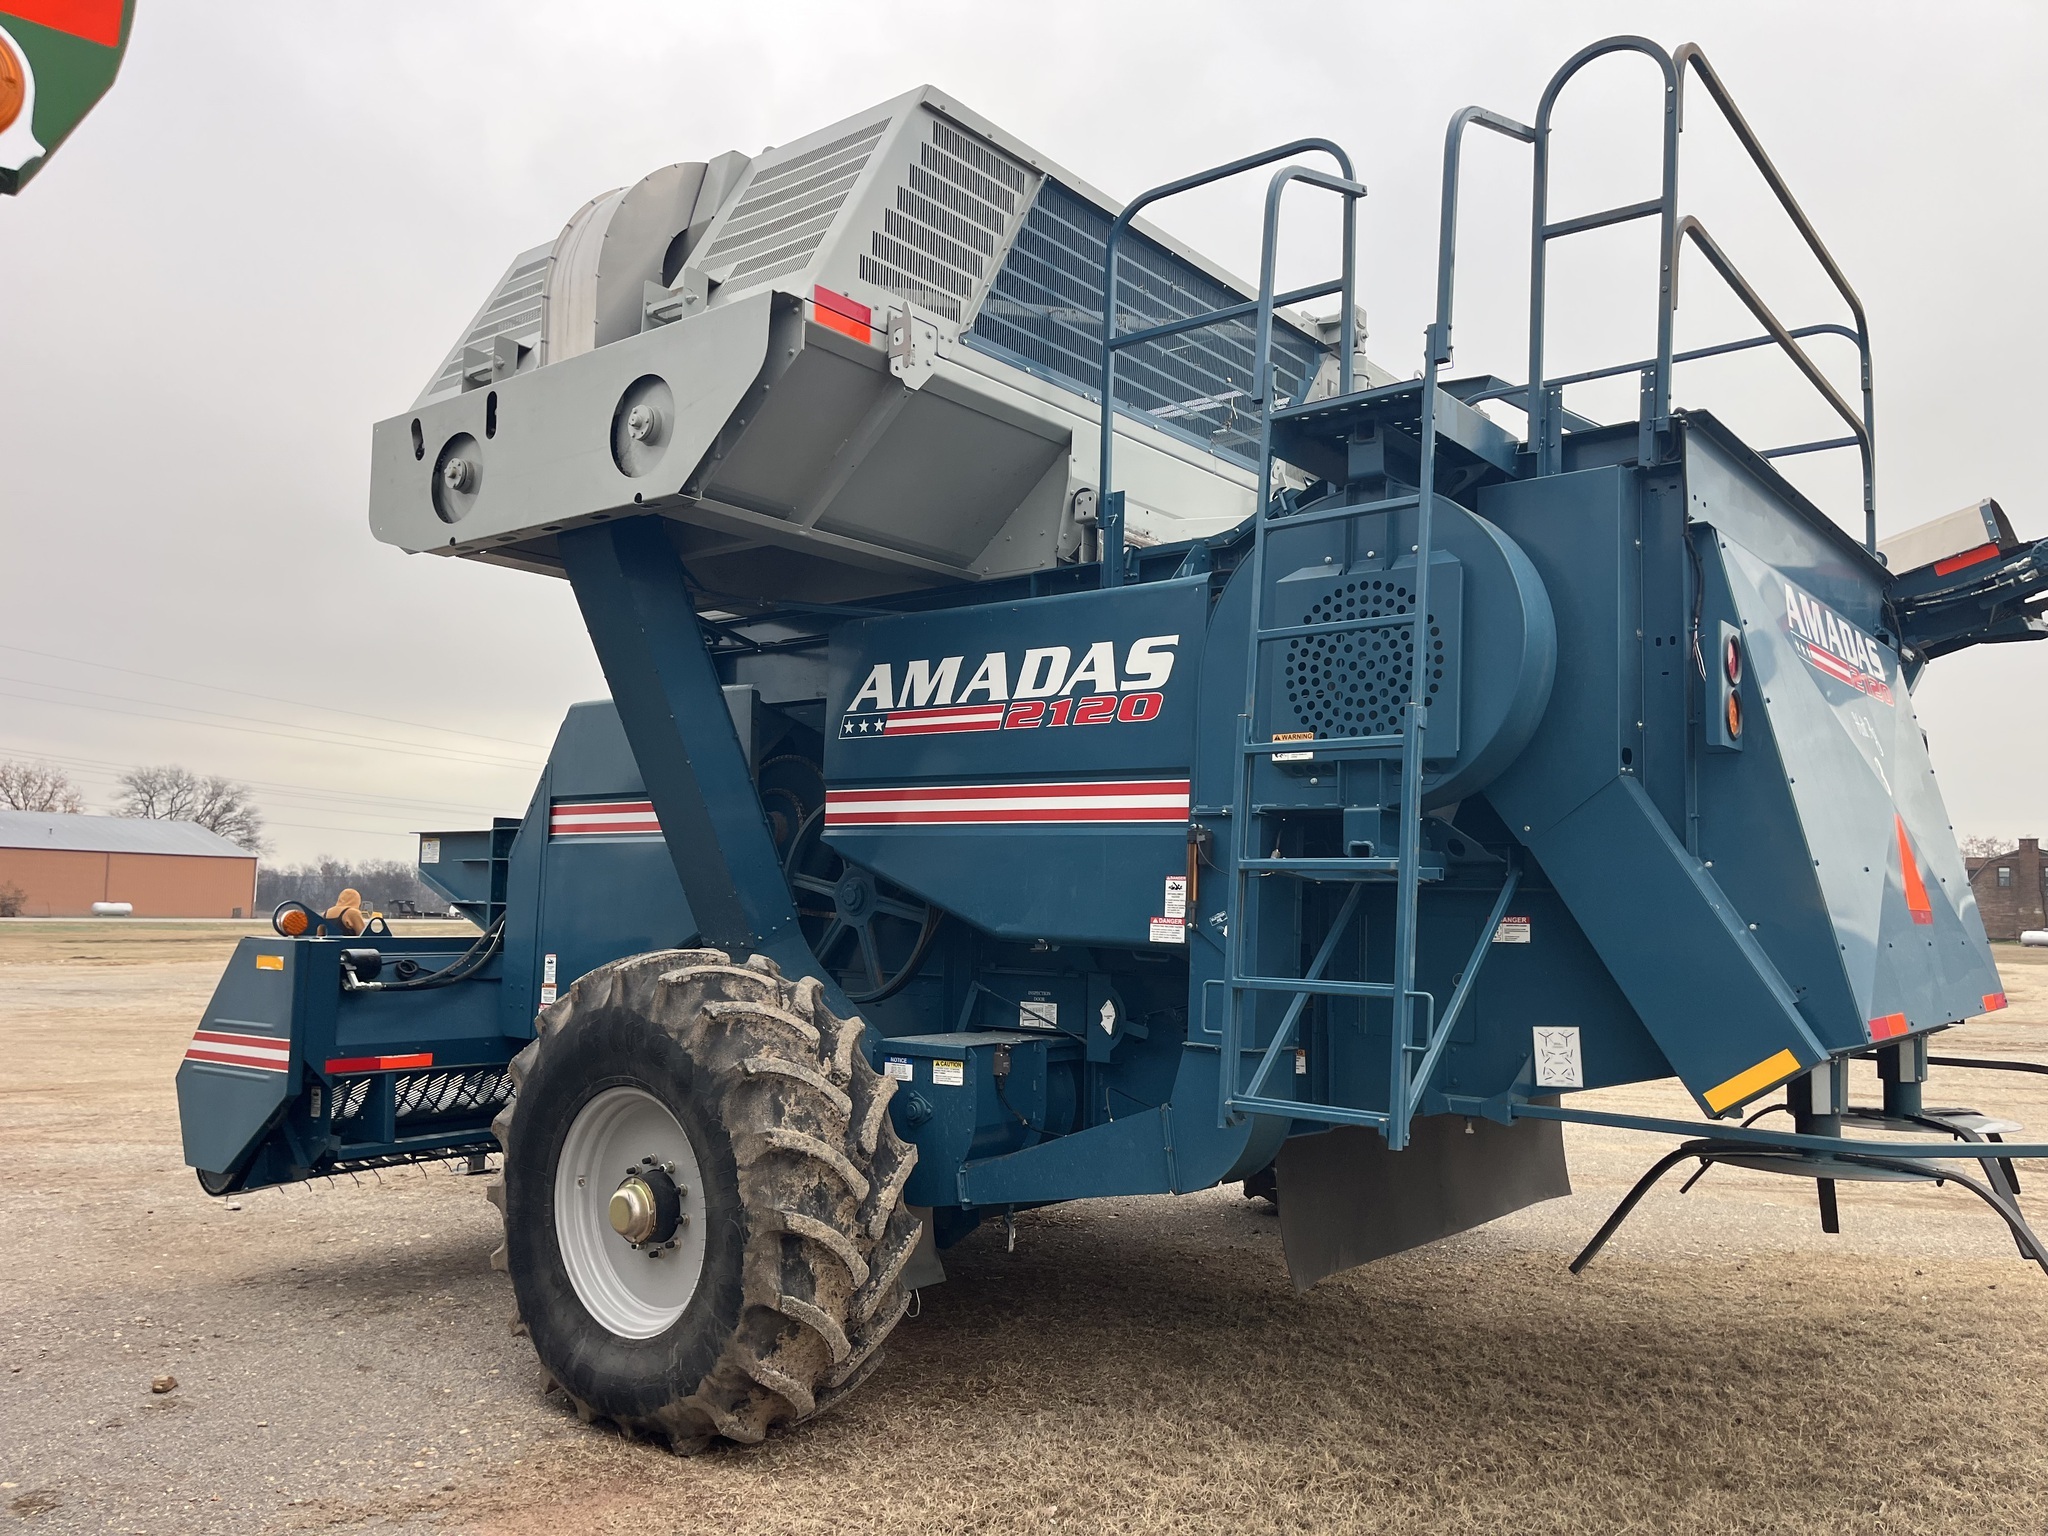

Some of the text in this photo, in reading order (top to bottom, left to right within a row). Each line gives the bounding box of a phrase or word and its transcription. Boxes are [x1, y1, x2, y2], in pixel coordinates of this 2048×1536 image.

[1785, 583, 1886, 682] AMADAS
[847, 634, 1180, 712] AMADAS
[1848, 664, 1895, 707] 2120
[1003, 692, 1165, 730] 2120
[1158, 917, 1183, 925] DANGER
